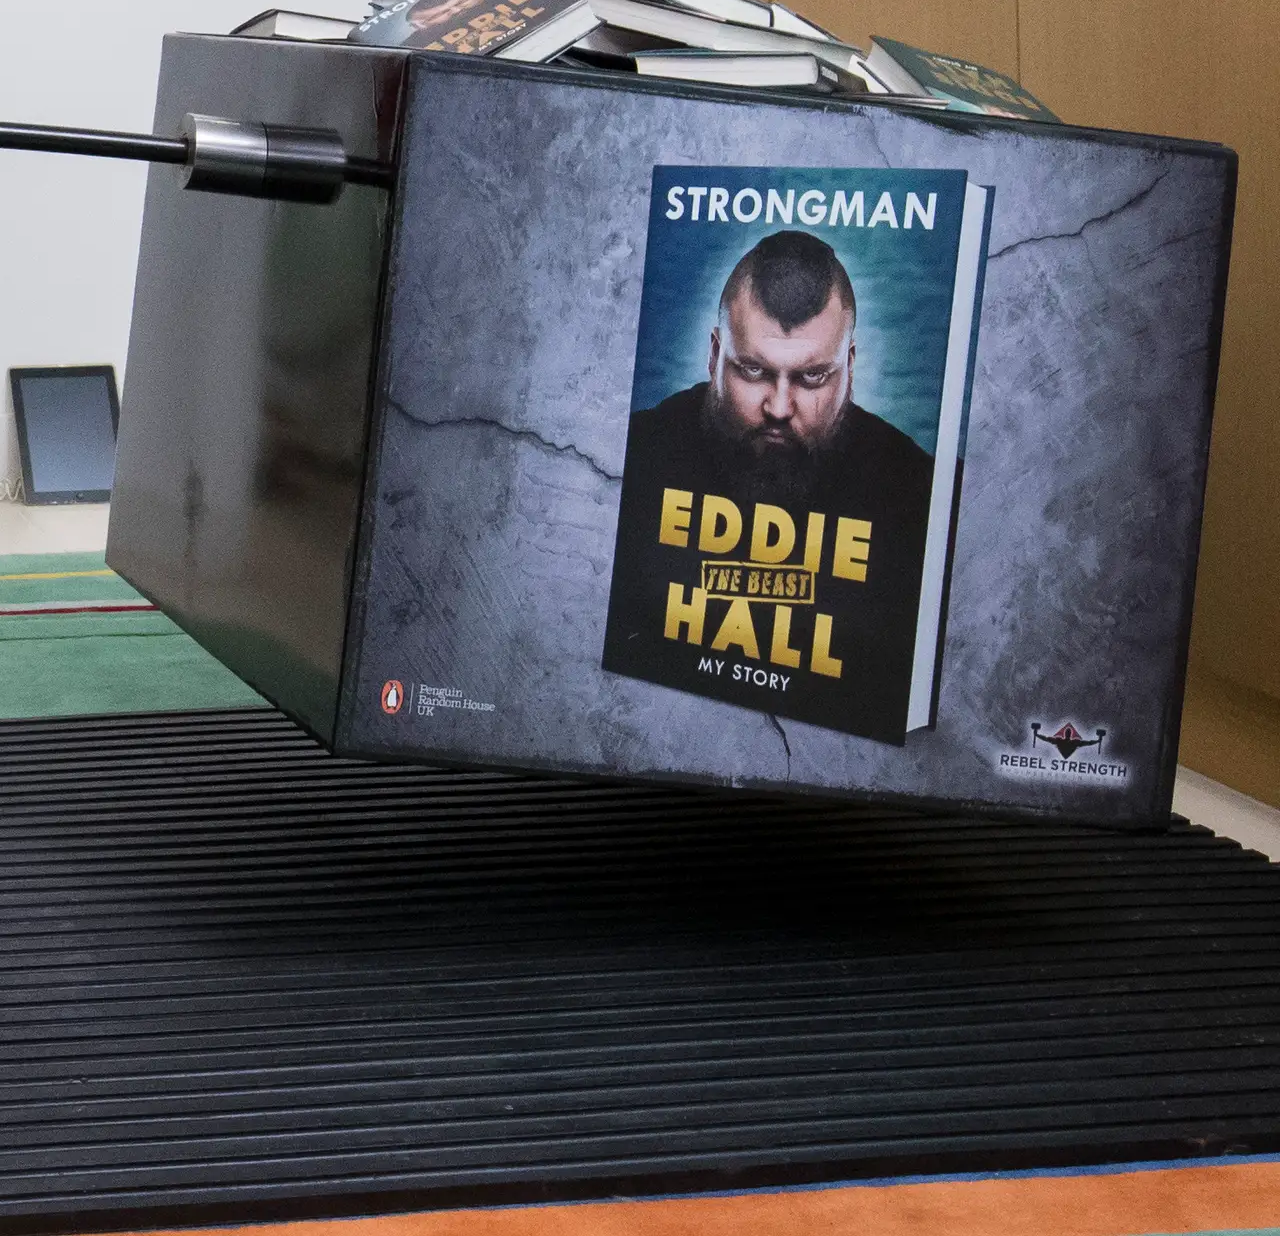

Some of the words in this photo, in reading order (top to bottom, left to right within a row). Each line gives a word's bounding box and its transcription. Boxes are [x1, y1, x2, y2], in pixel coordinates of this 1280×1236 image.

[666, 186, 937, 230] STRONGMAN
[659, 488, 872, 582] EDDIE
[706, 568, 742, 592] THE
[747, 570, 810, 597] BEAST
[664, 582, 843, 679] HALL
[698, 657, 725, 676] MY
[732, 664, 791, 692] STORY
[417, 695, 462, 709] Random
[463, 699, 496, 712] House
[419, 684, 463, 700] Penguin
[417, 706, 434, 716] UK
[1000, 754, 1046, 770] REBEL
[1051, 759, 1127, 777] STRENGTH
